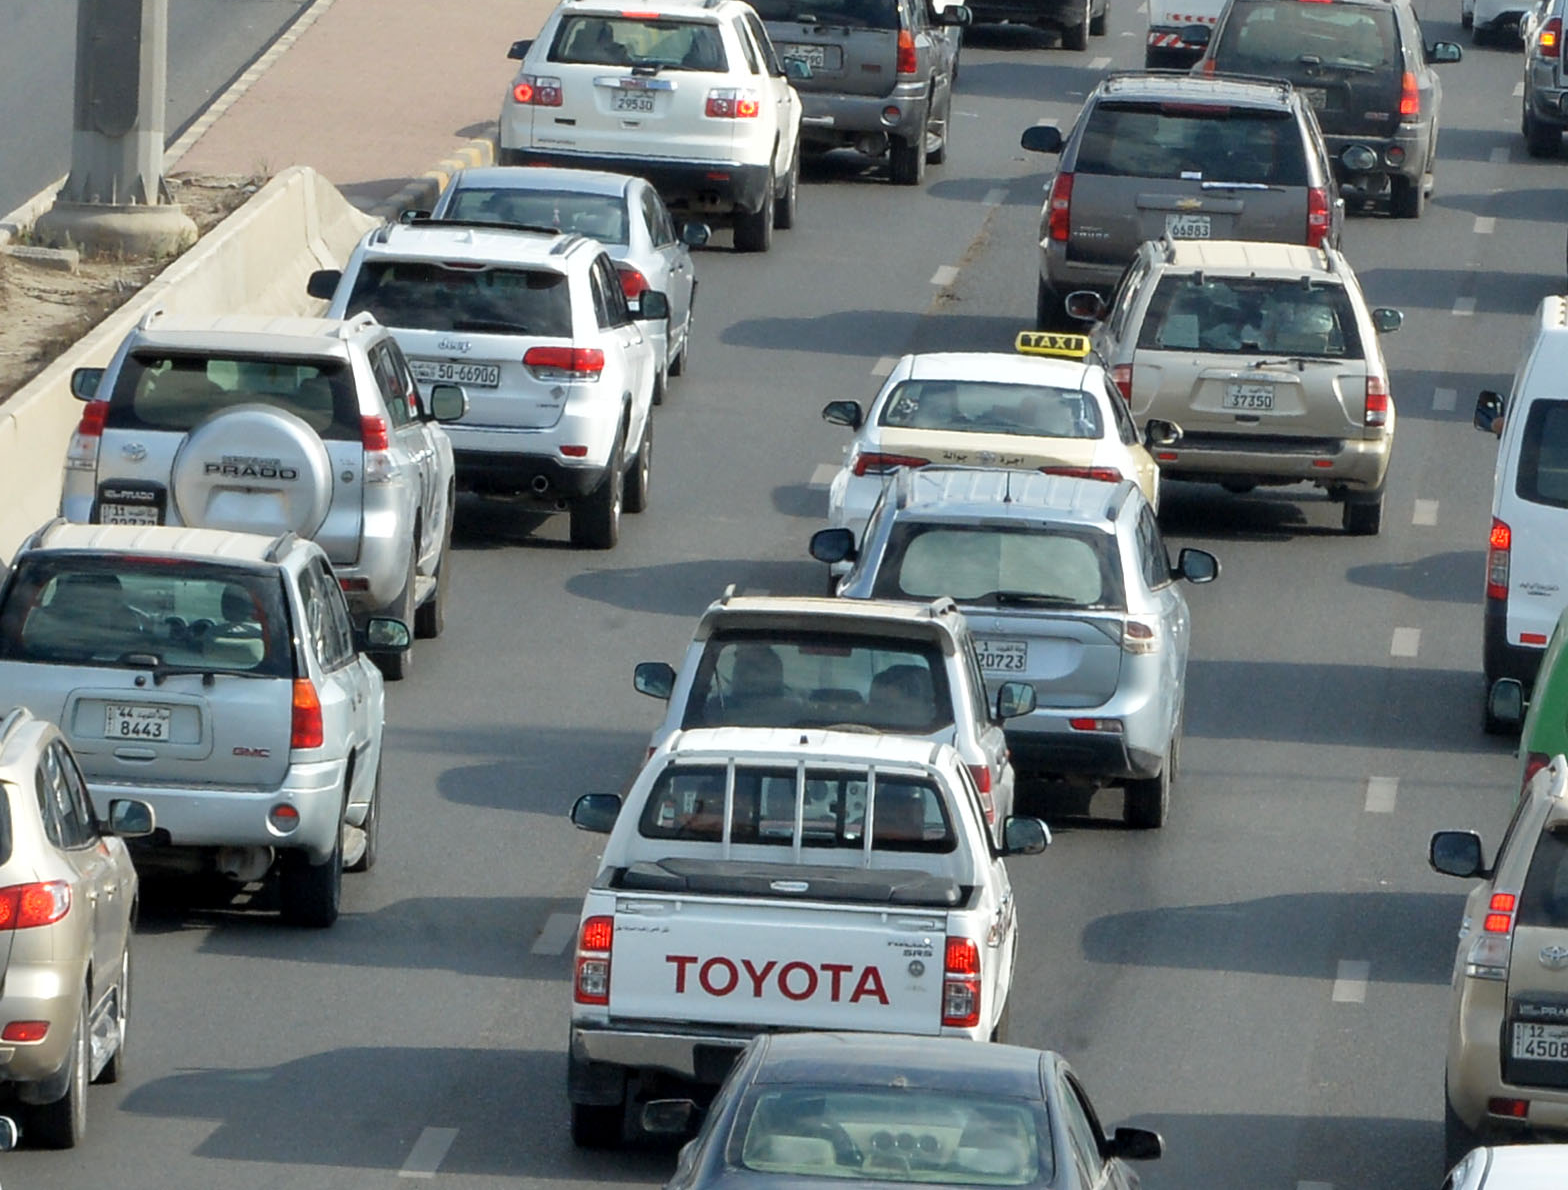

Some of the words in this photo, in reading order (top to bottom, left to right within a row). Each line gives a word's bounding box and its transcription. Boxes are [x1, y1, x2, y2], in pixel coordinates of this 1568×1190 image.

[1029, 334, 1077, 350] TAXI
[438, 364, 497, 384] 50-66906
[1232, 394, 1272, 409] 37350
[204, 462, 298, 481] PRADO
[978, 653, 1025, 669] 20723
[120, 720, 163, 738] 8443
[232, 746, 270, 758] GMC
[665, 954, 890, 1005] TOYOTA
[1529, 1025, 1545, 1039] 12
